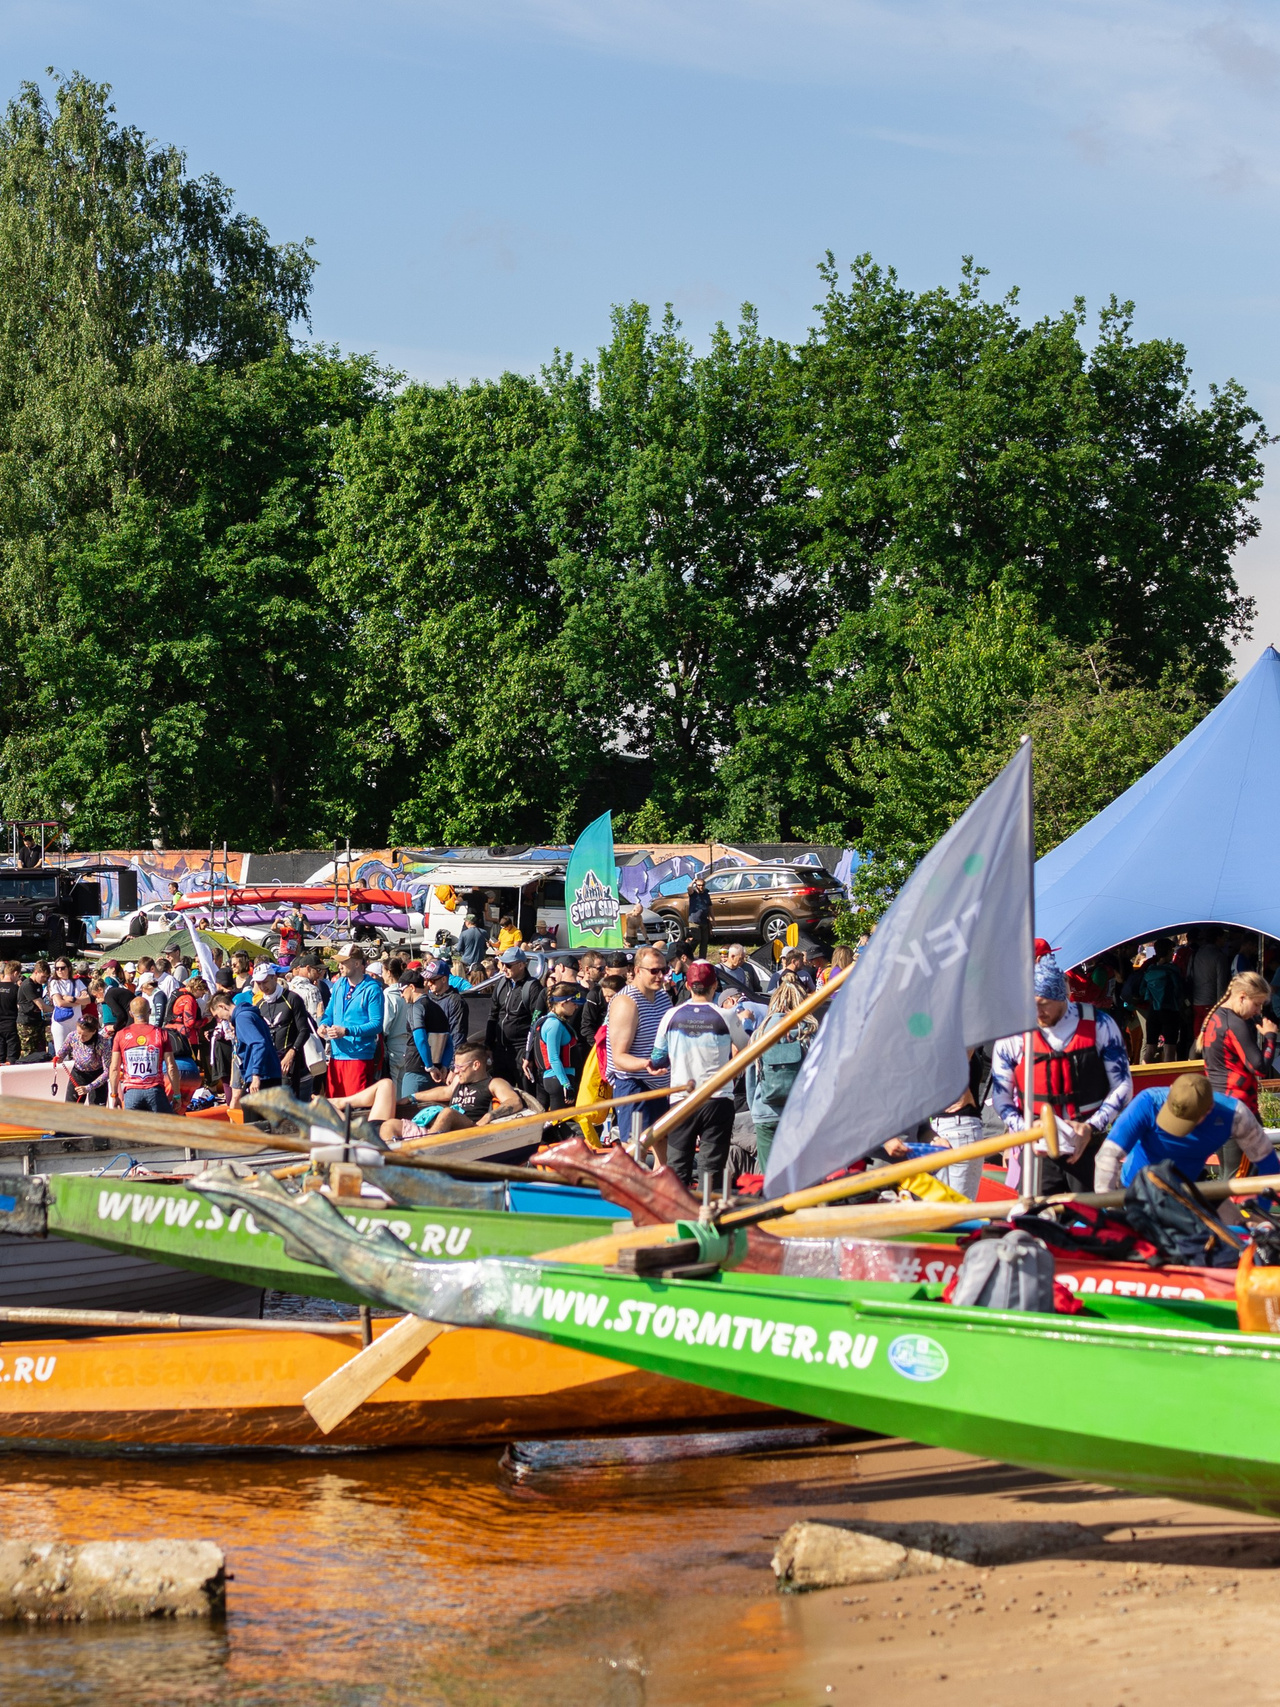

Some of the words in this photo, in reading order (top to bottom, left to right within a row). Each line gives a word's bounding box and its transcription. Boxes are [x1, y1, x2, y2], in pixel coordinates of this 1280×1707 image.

[572, 900, 596, 921] SVOY
[597, 900, 619, 917] SUP
[132, 1063, 153, 1074] 704
[511, 1283, 879, 1370] WWW.STORMTVER.RU
